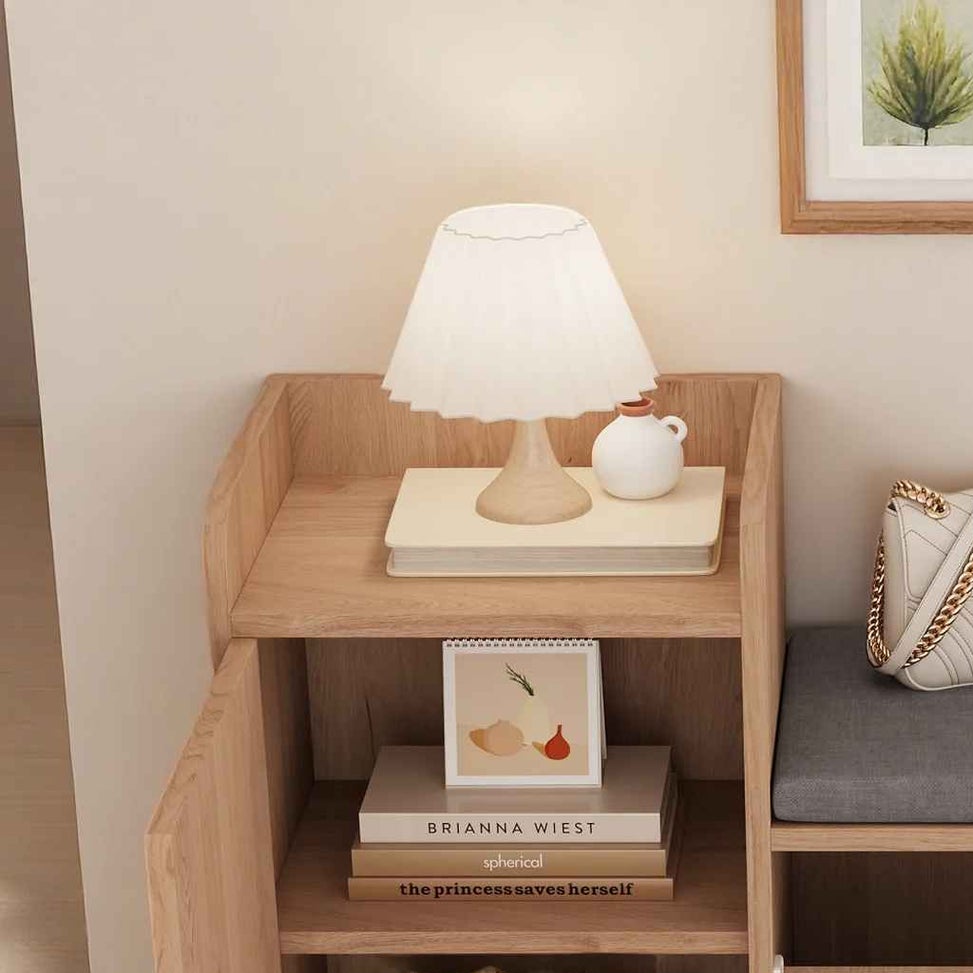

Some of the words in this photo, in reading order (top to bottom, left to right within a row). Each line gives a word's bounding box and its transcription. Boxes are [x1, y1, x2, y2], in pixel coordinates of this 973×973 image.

[428, 822, 523, 834] BRIANNA
[533, 822, 596, 834] WIEST
[483, 853, 543, 871] spherical
[400, 882, 430, 896] the
[434, 882, 513, 898] princess
[514, 885, 565, 896] saves
[568, 882, 633, 896] herself
